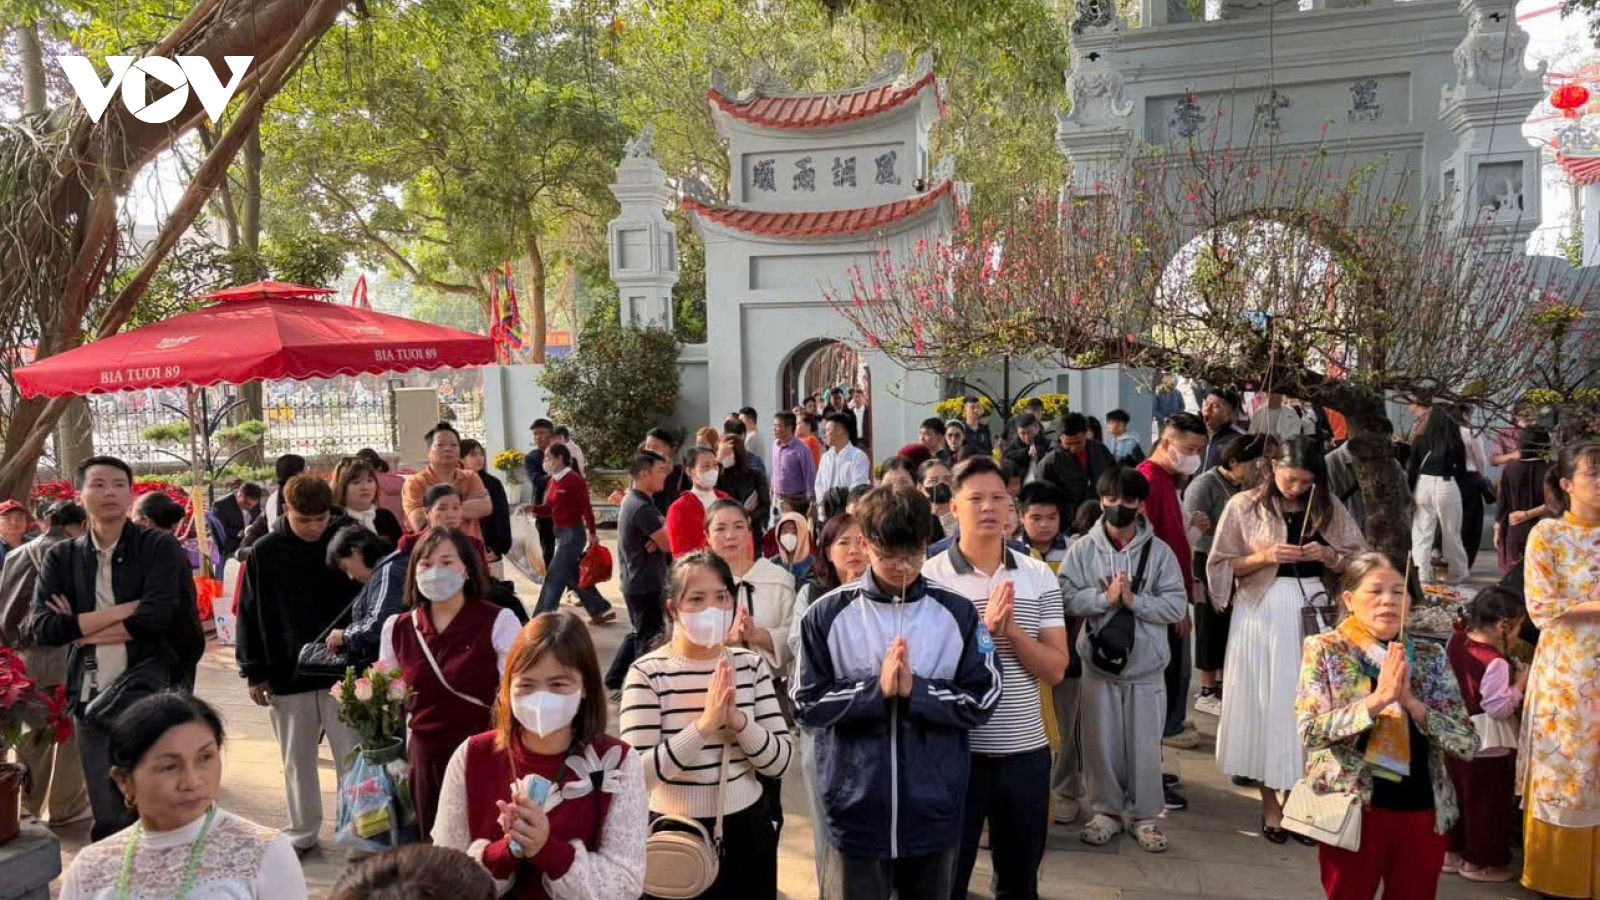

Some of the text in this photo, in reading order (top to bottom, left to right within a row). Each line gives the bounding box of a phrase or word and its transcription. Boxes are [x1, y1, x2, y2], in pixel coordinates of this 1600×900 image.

[375, 349, 394, 361] BIA
[425, 347, 437, 359] 89
[100, 370, 123, 384] BIA
[164, 365, 180, 379] 89
